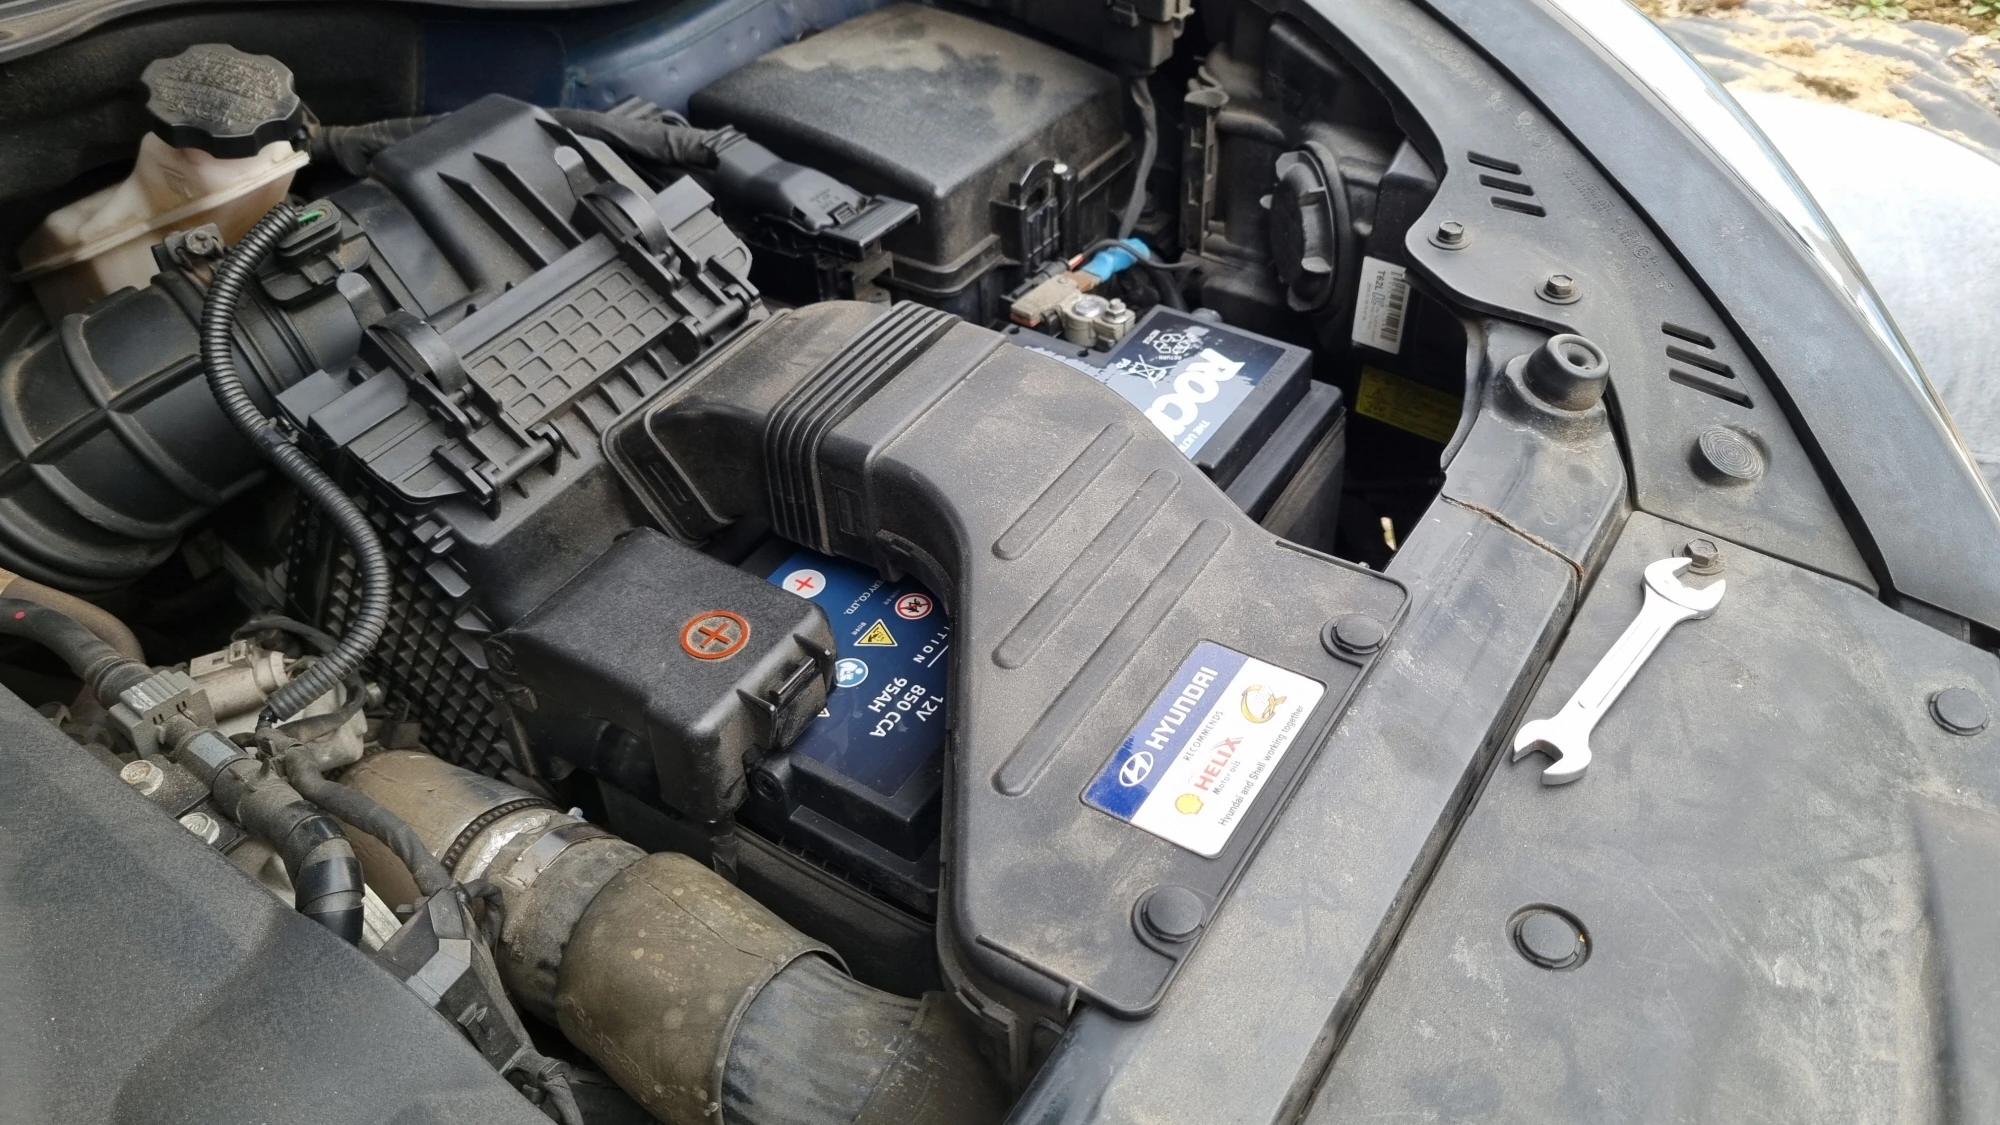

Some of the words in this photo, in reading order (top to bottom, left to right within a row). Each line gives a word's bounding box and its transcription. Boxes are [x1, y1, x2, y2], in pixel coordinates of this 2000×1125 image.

[1374, 270, 1386, 291] T62L
[1193, 419, 1211, 436] THE
[868, 677, 908, 713] 95AH
[896, 684, 926, 712] 850
[915, 695, 944, 722] 12V
[1145, 666, 1218, 751] HYUNDAI
[869, 711, 902, 738] CCA
[1183, 711, 1224, 761] RECOMMENDS
[1194, 736, 1244, 792] HELIX
[1213, 773, 1232, 795] Motor
[1230, 760, 1241, 774] oils
[1217, 794, 1244, 827] Hyundai
[1242, 779, 1254, 796] and
[1249, 761, 1265, 781] Shell
[1264, 733, 1286, 762] working
[1281, 704, 1304, 734] together
